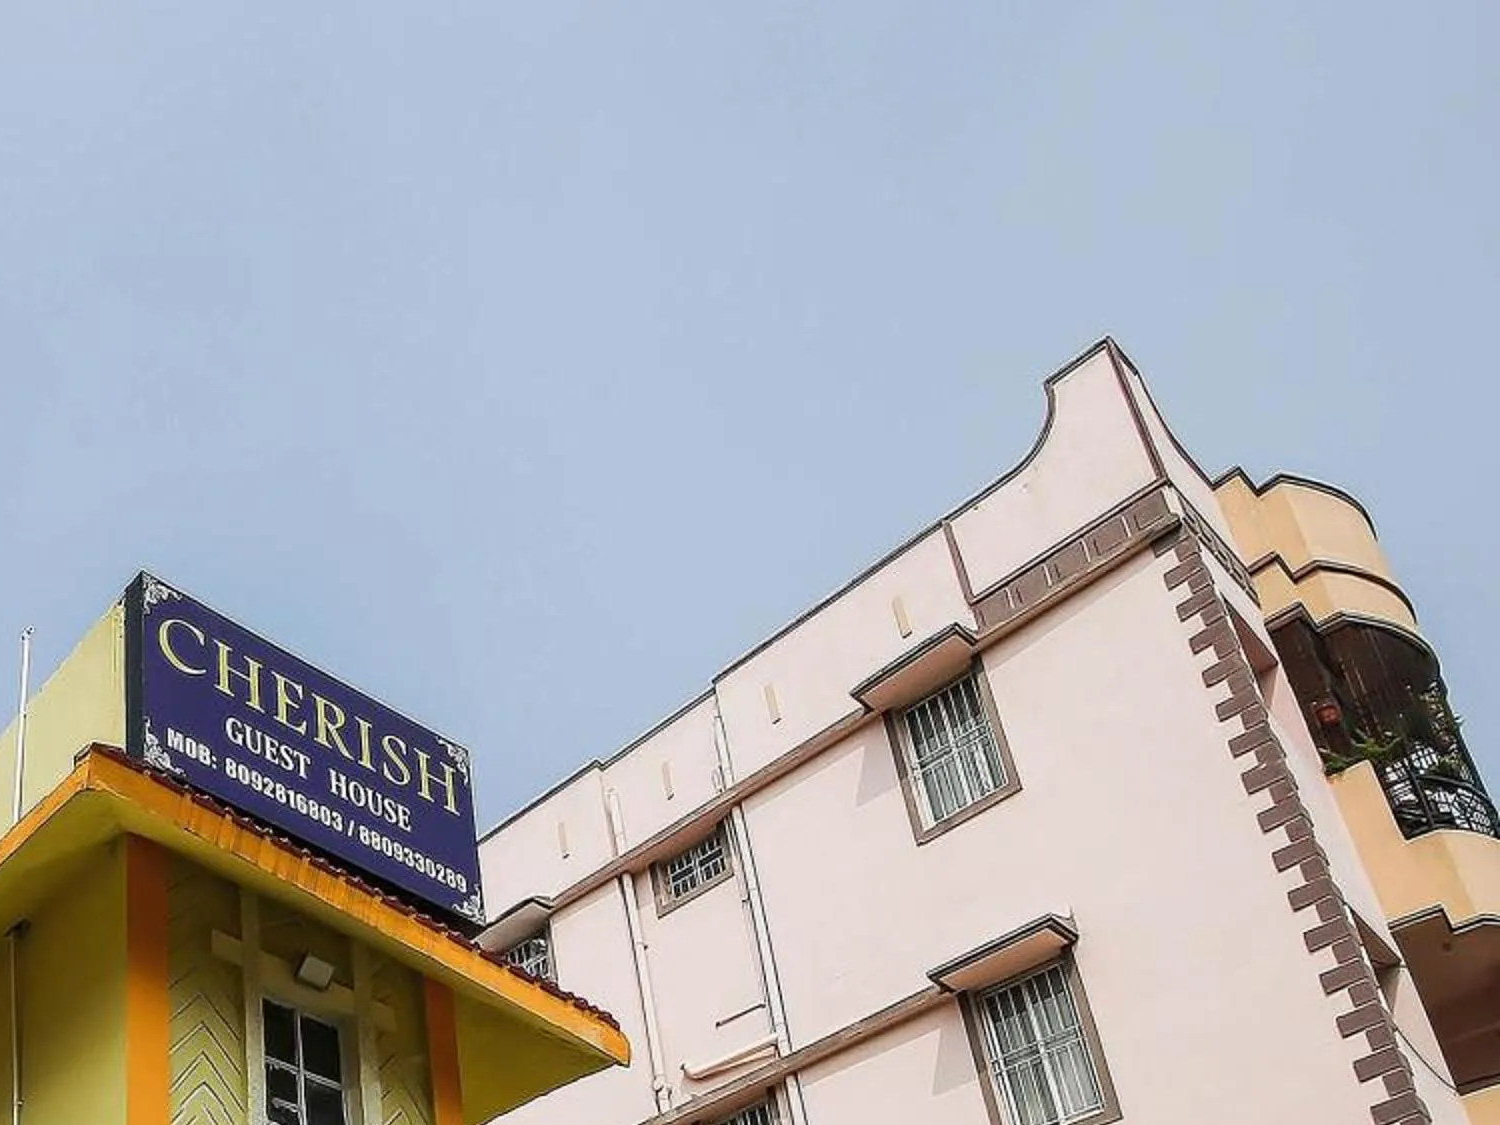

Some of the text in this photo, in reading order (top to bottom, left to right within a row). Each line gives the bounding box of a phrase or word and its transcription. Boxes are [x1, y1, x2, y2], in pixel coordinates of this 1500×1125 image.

[158, 619, 460, 816] CHERISH
[225, 717, 411, 832] GUEST HOUSE
[167, 727, 218, 769] MOB:
[225, 757, 343, 832] 8092816803
